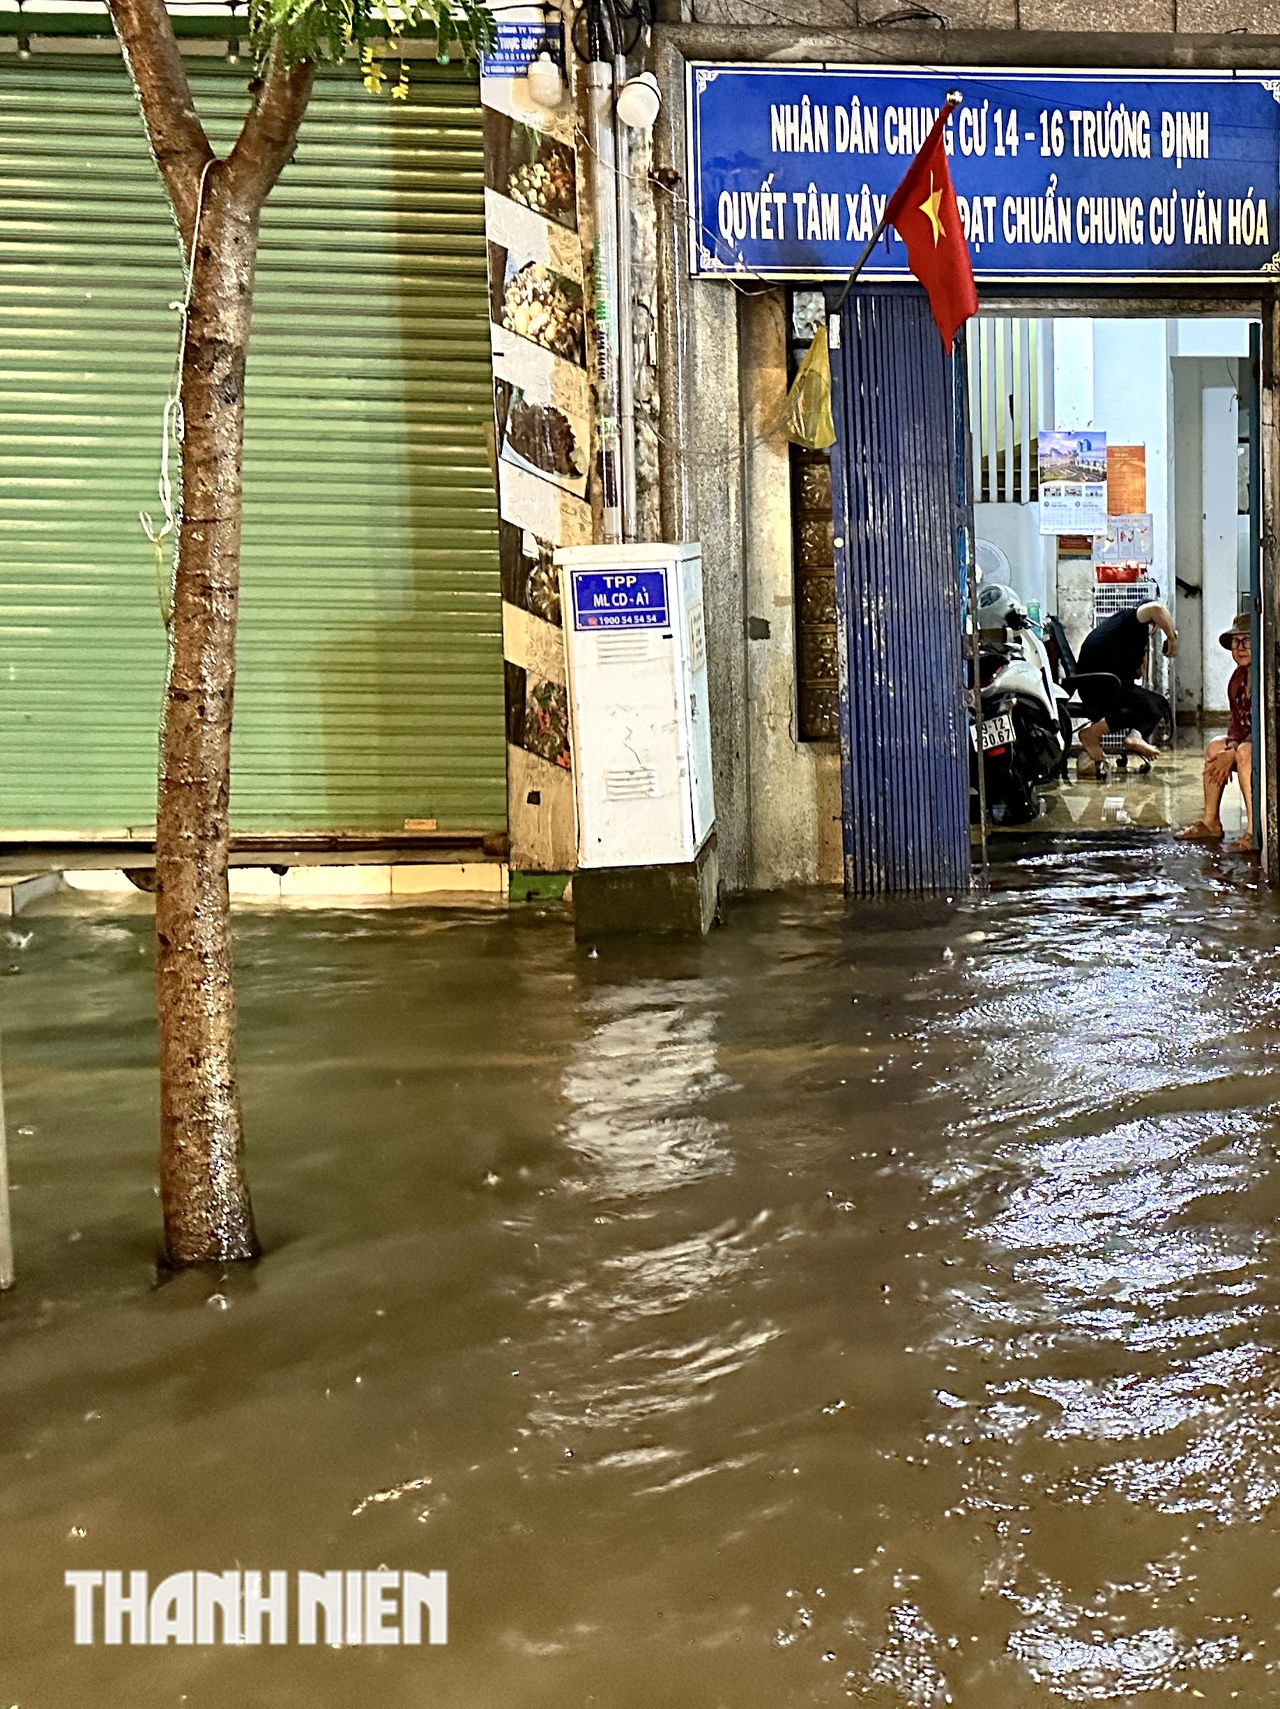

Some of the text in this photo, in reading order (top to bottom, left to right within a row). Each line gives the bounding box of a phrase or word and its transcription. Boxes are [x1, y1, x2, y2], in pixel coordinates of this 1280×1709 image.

[771, 94, 829, 153] NHÂN
[835, 95, 879, 154] DÂN
[959, 98, 989, 157] CƯ
[993, 108, 1019, 157] 14
[1039, 109, 1065, 158] 16
[1069, 100, 1151, 159] TRƯƠNG
[1161, 111, 1209, 169] ĐỊNH
[717, 173, 787, 249] QUYẾT
[793, 182, 846, 241] TÂM
[845, 183, 887, 243] XÂY
[955, 196, 997, 253] ĐẠT
[1002, 173, 1072, 244] CHUẨN
[1076, 196, 1144, 245] CHUNG
[1149, 188, 1178, 244] CƯ
[1181, 189, 1222, 245] VĂN
[1228, 186, 1269, 246] HÓA
[602, 575, 637, 589] TPP
[599, 613, 657, 625] 1900 54 54 54
[982, 717, 1005, 735] 9-T2
[975, 728, 1010, 748] 30.67
